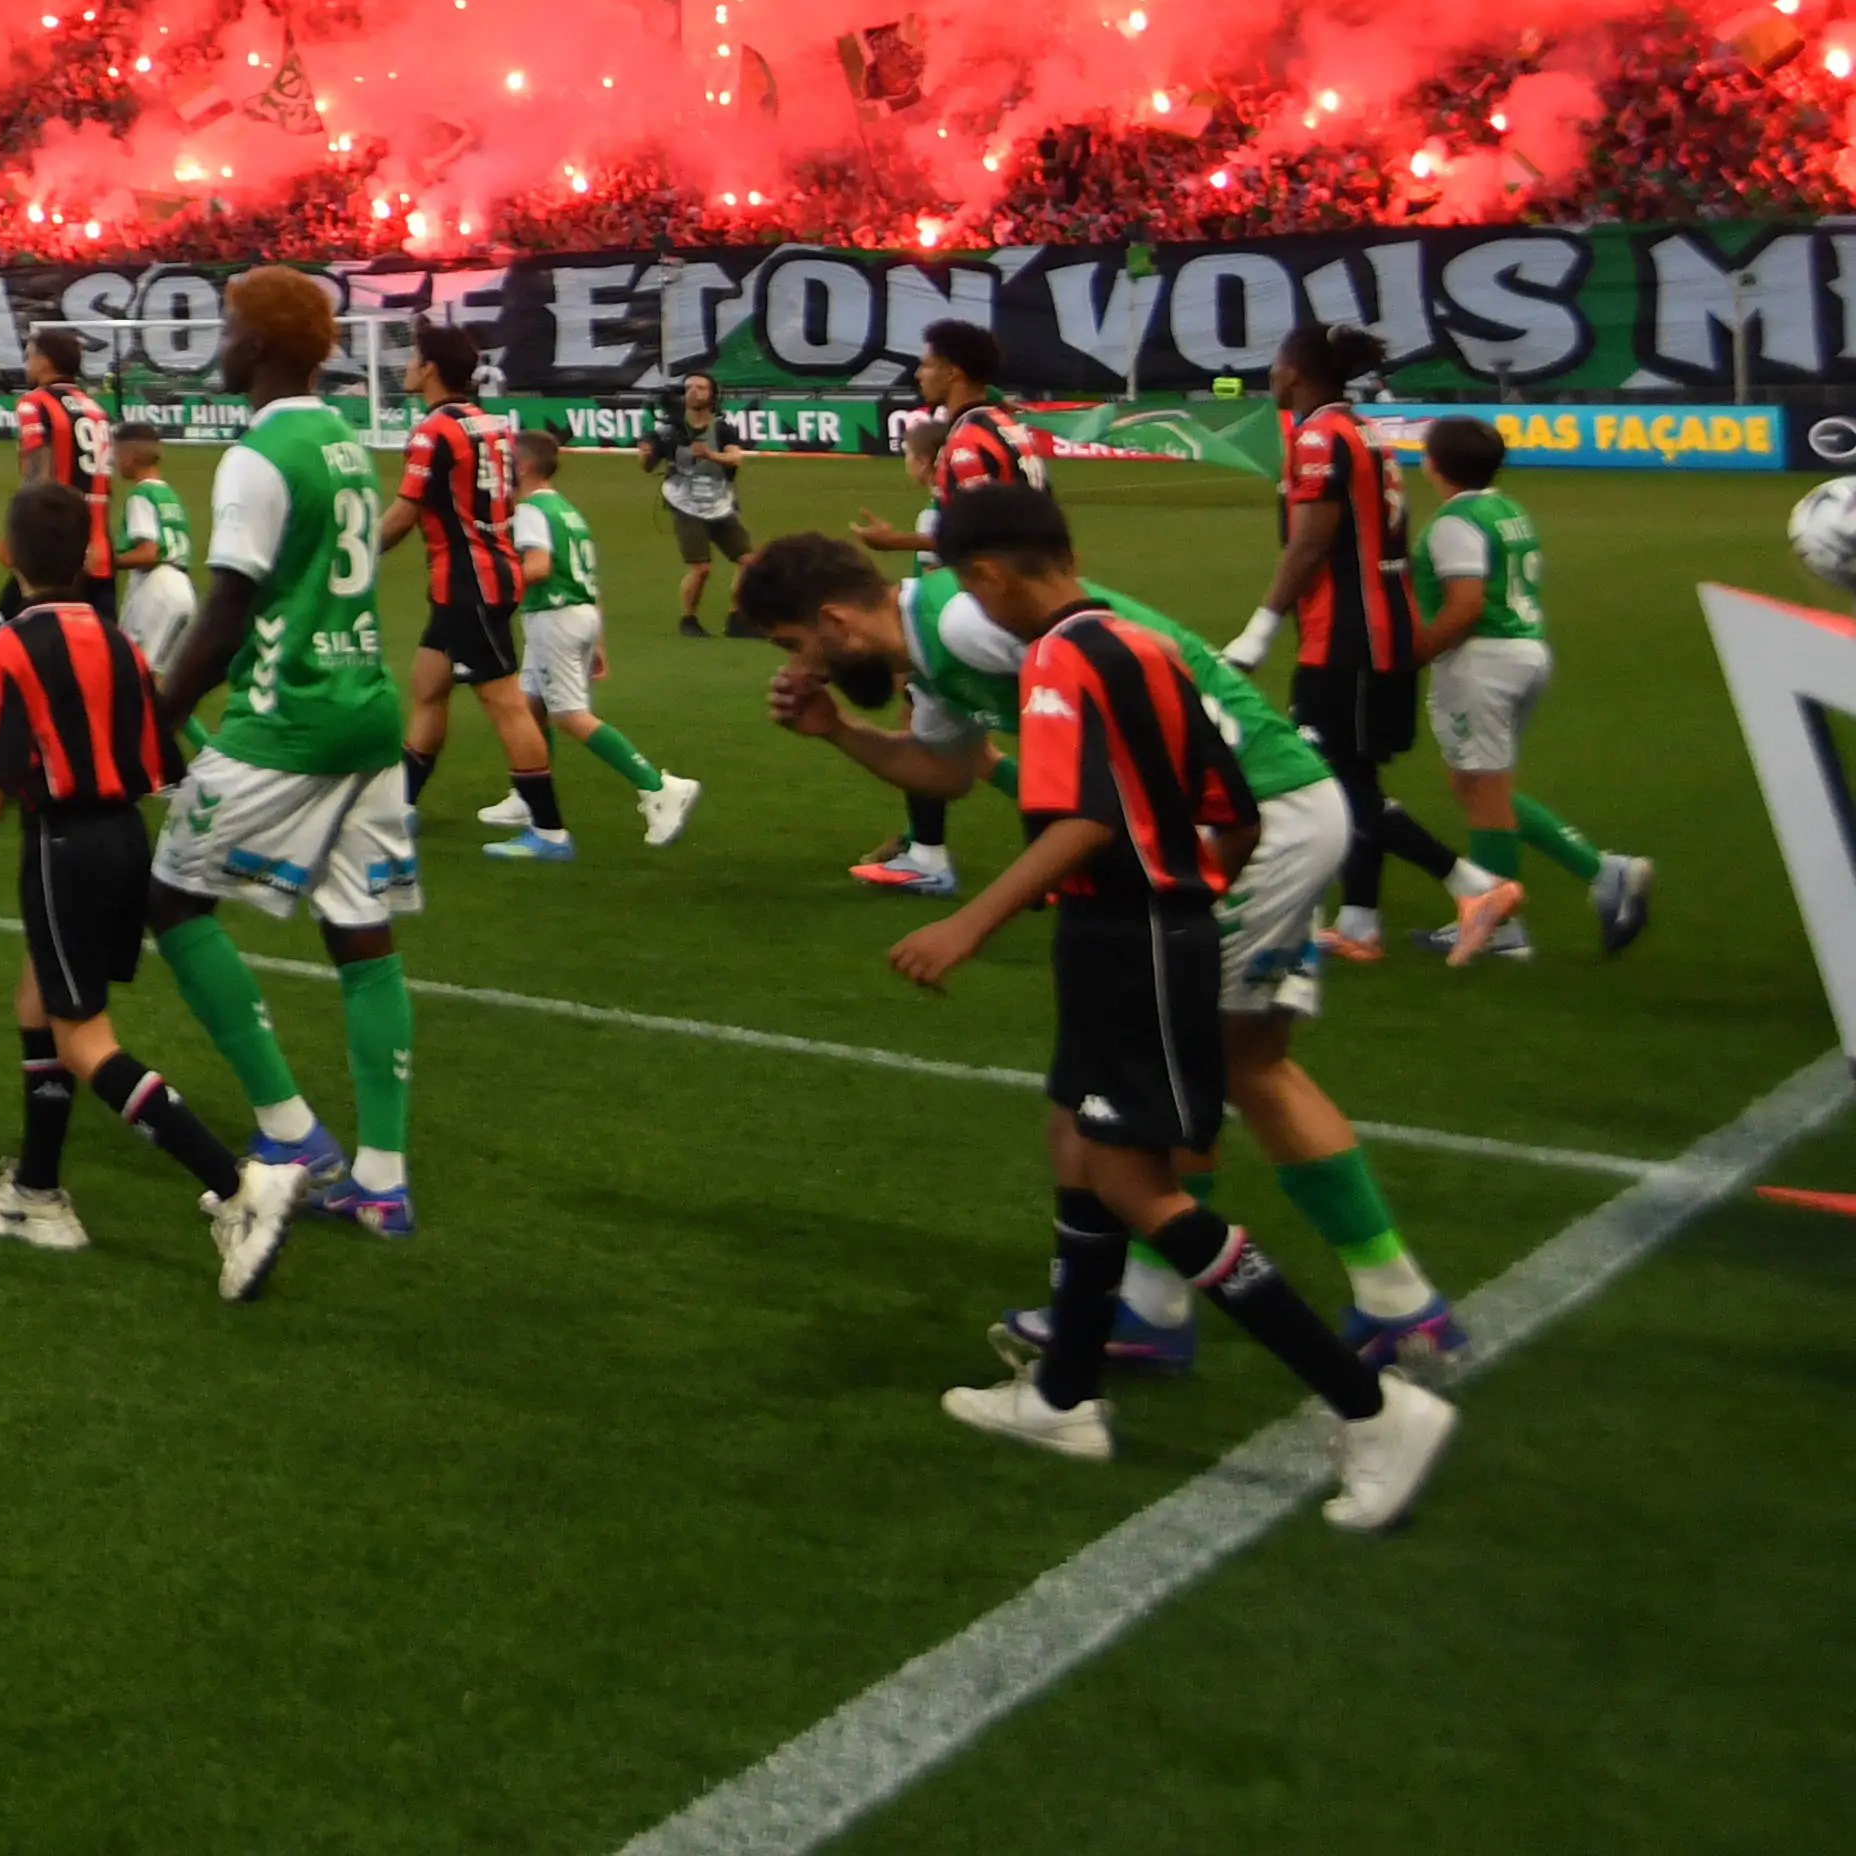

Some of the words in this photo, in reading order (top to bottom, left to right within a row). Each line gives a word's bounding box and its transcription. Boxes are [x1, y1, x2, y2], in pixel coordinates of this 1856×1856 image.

[545, 262, 737, 371] ET
[1045, 236, 1581, 379] VOUS
[121, 403, 185, 425] VISIT
[566, 408, 644, 438] VISIT
[725, 409, 841, 442] MEL.FR
[1594, 414, 1773, 462] FAÇADE
